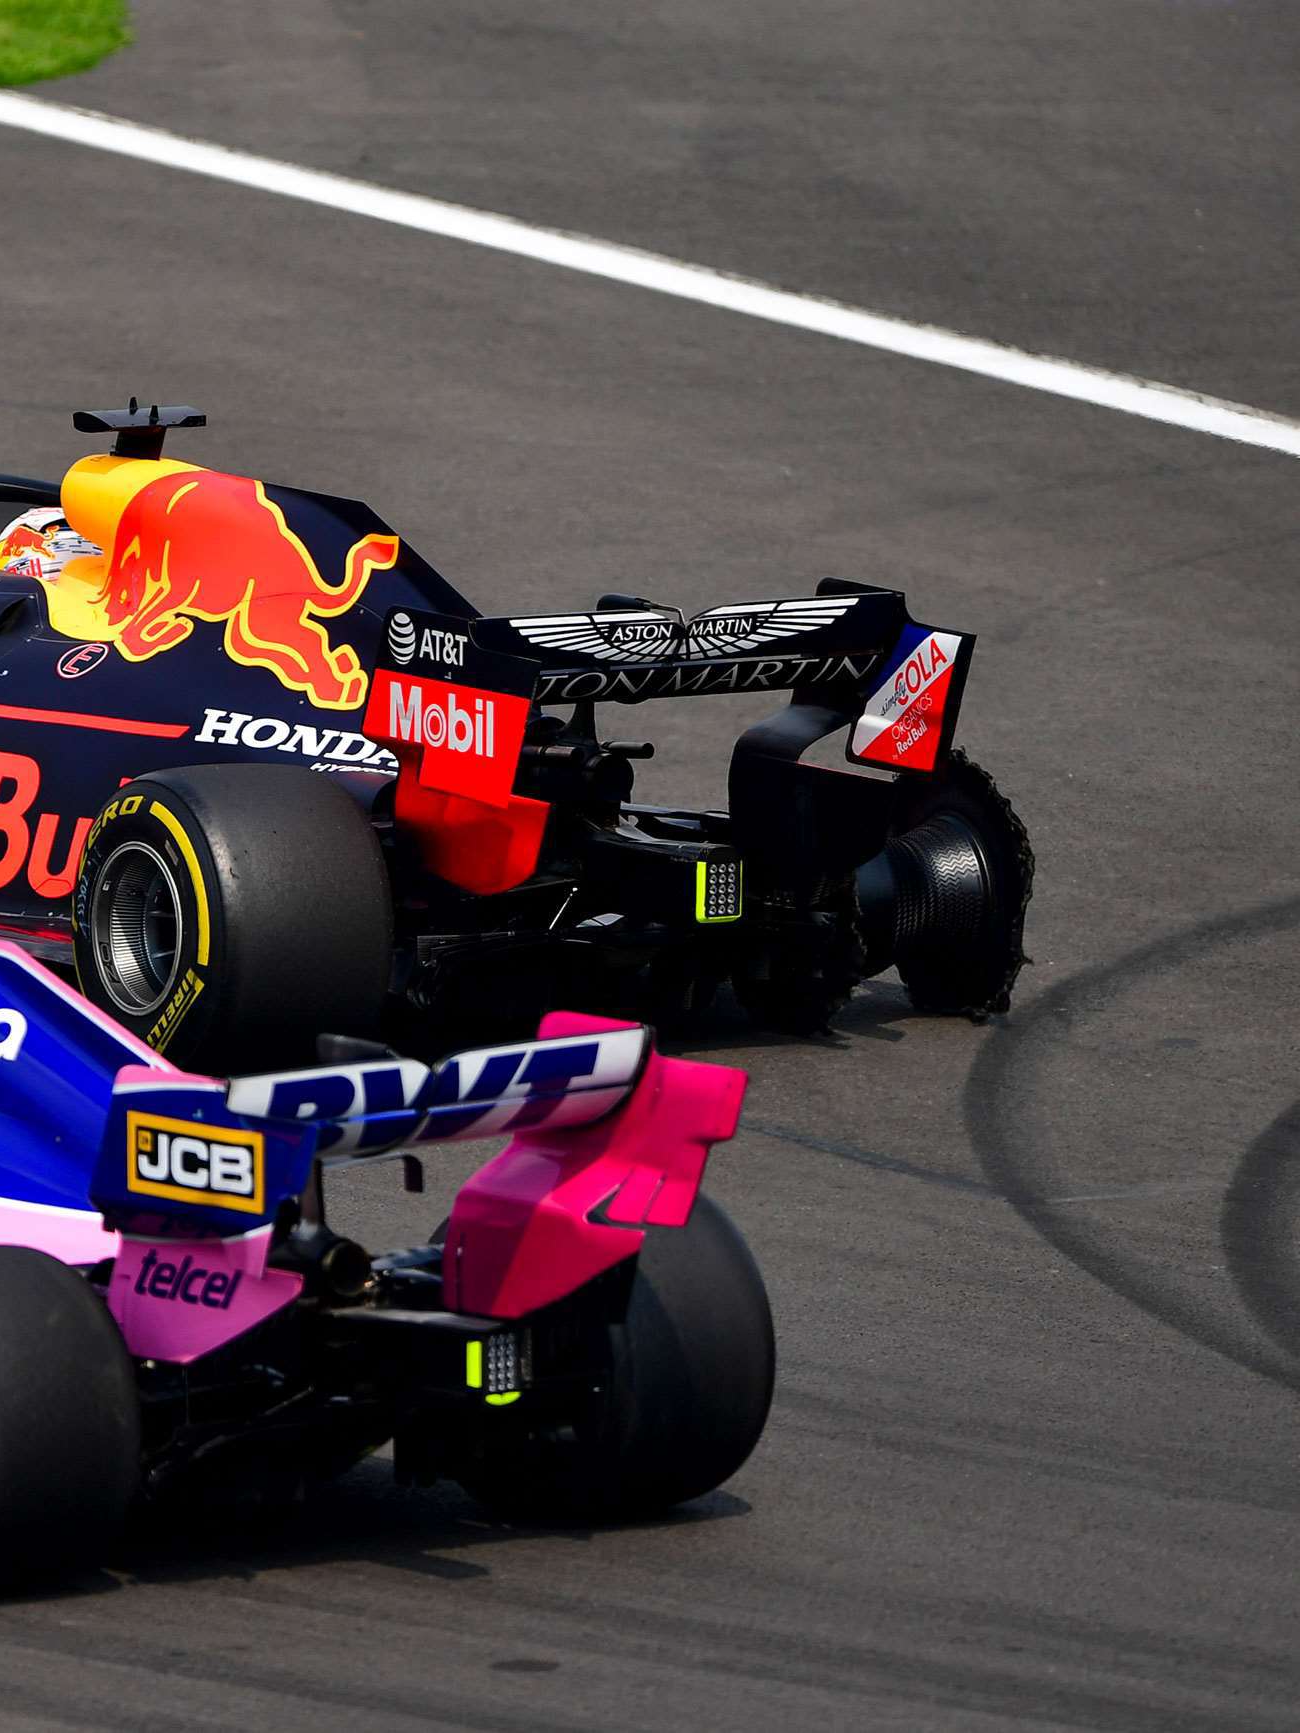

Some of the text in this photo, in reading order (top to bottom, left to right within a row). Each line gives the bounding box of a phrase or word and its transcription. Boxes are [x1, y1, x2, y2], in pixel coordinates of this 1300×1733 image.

[419, 628, 468, 667] AT&T
[612, 618, 752, 641] ASTON MARTIN
[537, 655, 878, 700] TON MARTIN
[894, 638, 948, 706] COLA
[194, 707, 399, 769] HONDA
[389, 681, 494, 758] Mobil
[891, 692, 933, 740] ORGANICS
[896, 719, 928, 755] Red Bull
[87, 795, 144, 849] ERO
[147, 968, 205, 1054] PIRELLI
[266, 1042, 600, 1150] BWT
[138, 1133, 253, 1195] JCB
[134, 1248, 244, 1310] telcel
